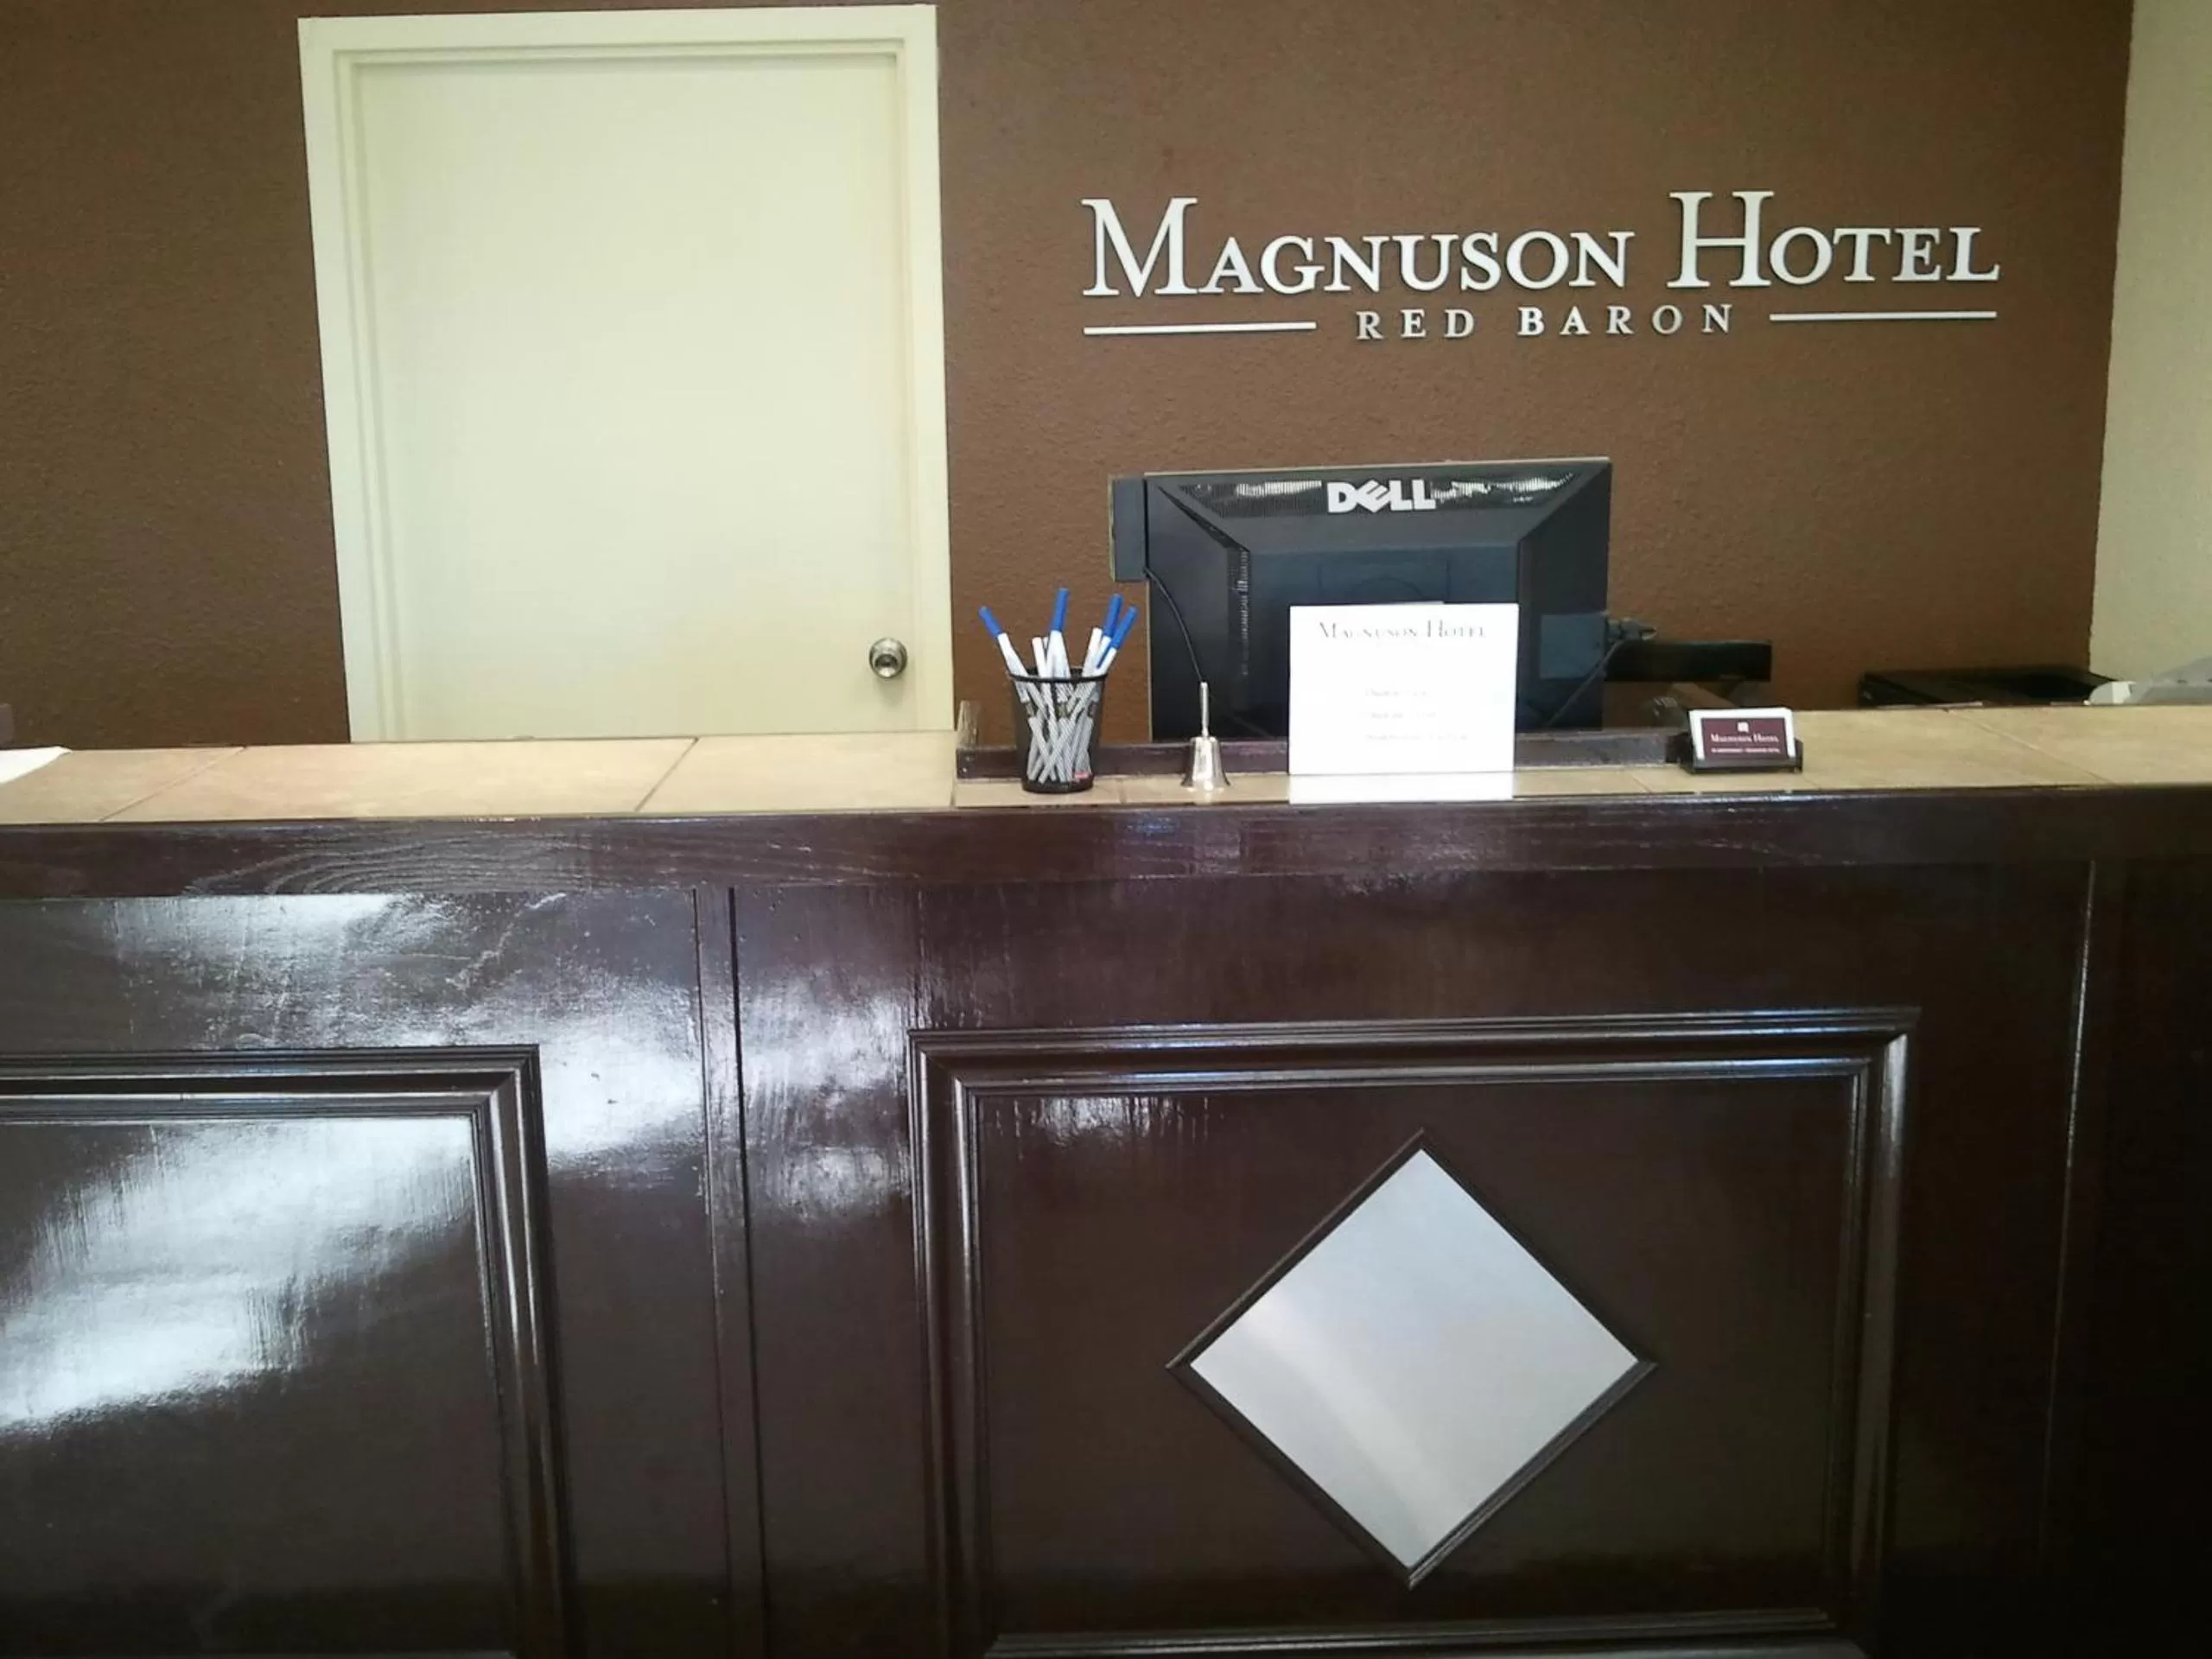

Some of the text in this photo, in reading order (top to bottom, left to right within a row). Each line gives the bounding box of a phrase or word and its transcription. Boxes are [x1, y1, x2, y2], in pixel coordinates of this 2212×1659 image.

[1081, 190, 2000, 298] MAGNUSON HOTEL
[1356, 303, 1733, 340] RED BARON
[1326, 479, 1437, 513] DELL
[1319, 620, 1419, 639] MANUSON
